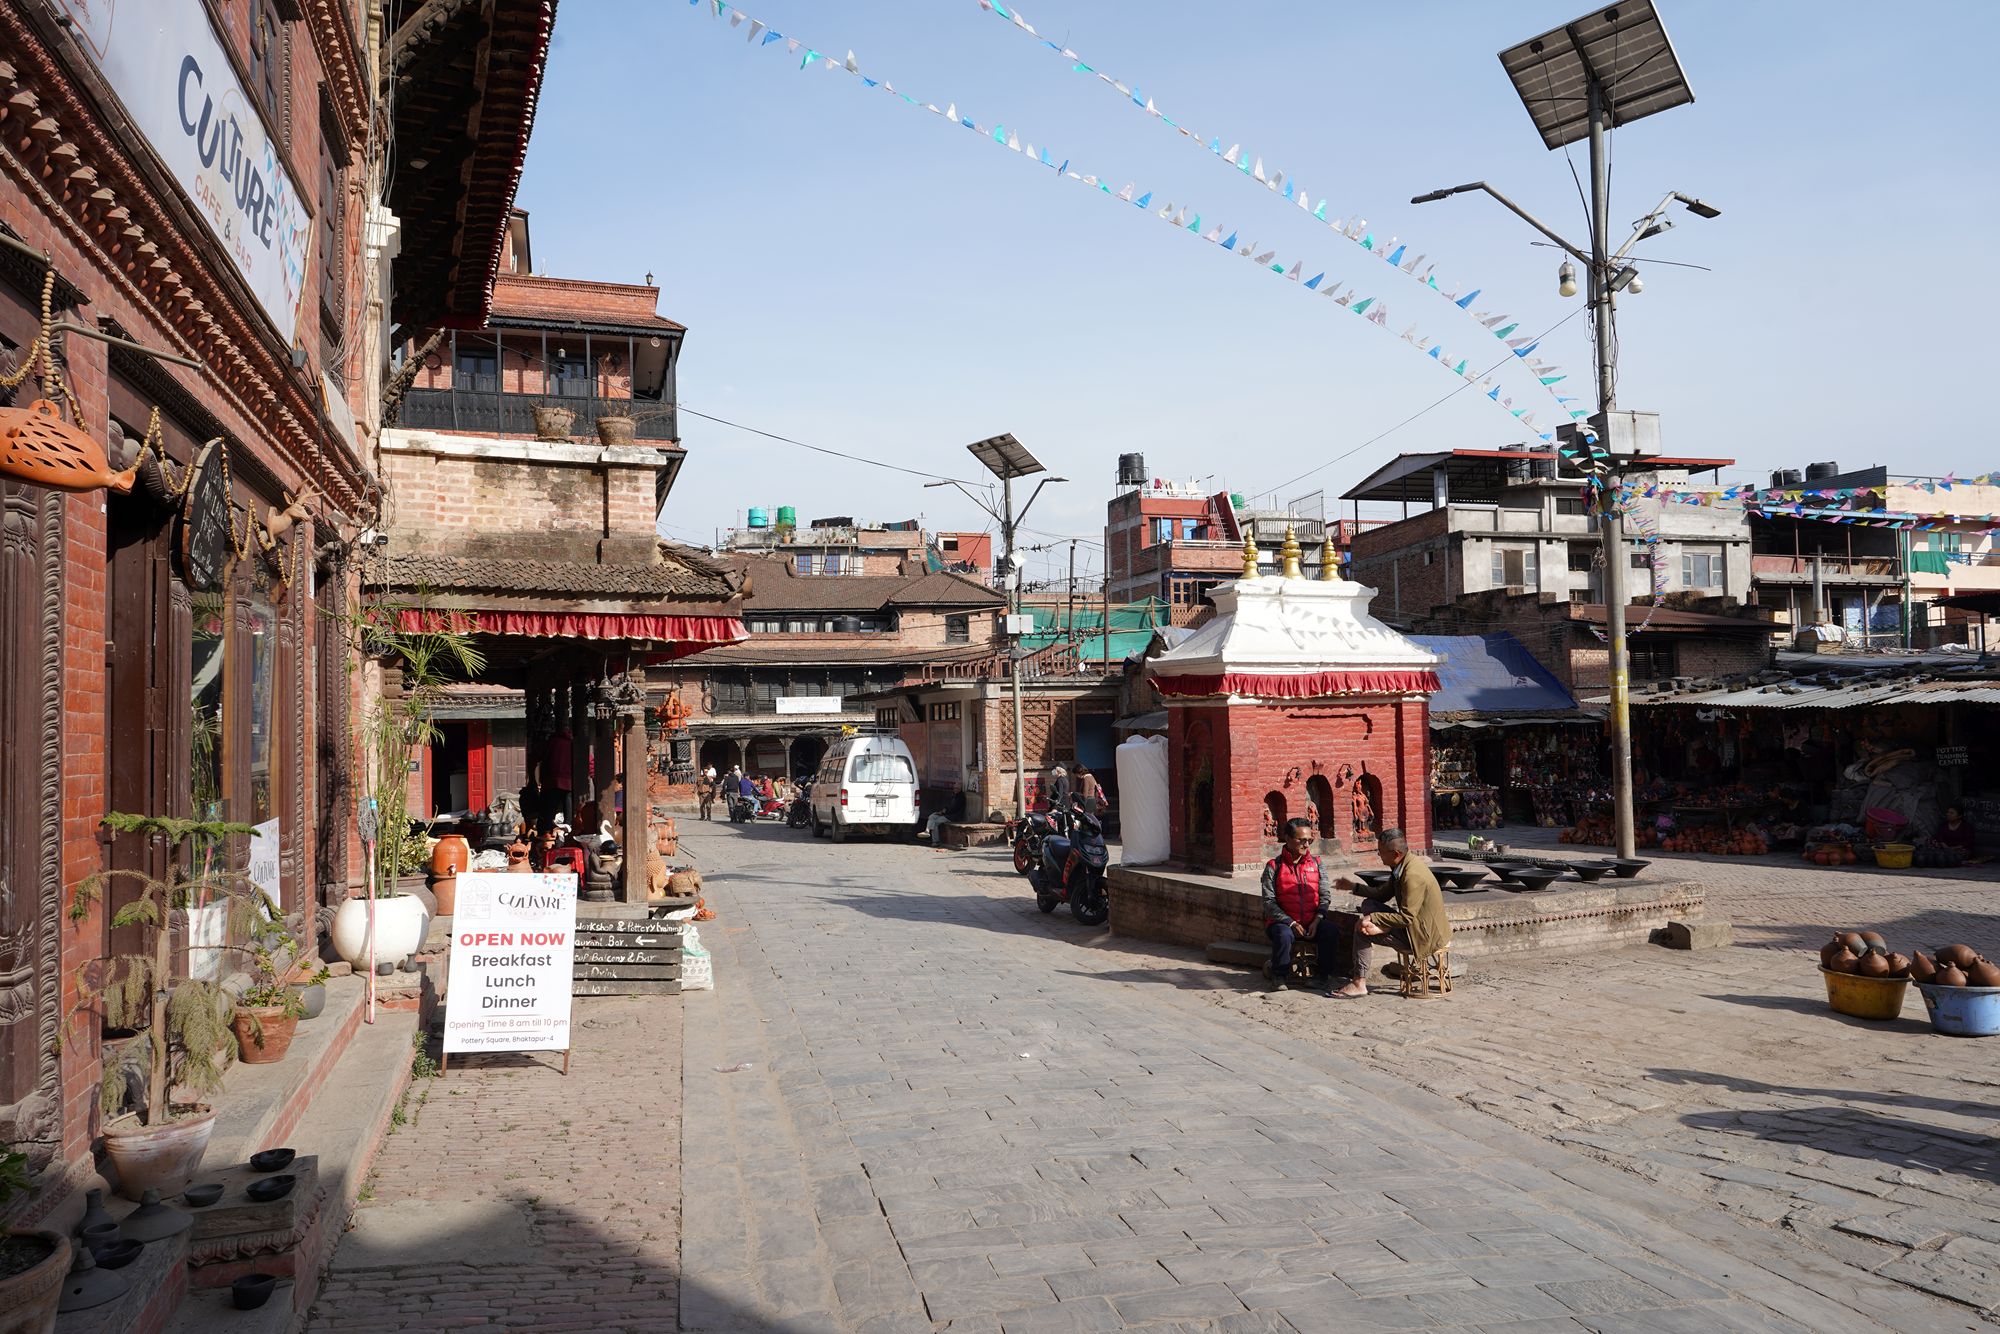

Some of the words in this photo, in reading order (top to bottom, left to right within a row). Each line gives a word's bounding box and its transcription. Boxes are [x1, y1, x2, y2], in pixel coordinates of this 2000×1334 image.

[177, 54, 276, 251] CULTURE
[224, 217, 232, 242] &
[235, 235, 252, 273] BAR
[498, 893, 566, 910] CULTURE
[617, 920, 626, 932] &
[460, 933, 514, 946] OPEN
[520, 932, 566, 946] NOW
[471, 954, 552, 967] Breakfast
[627, 952, 636, 963] &
[636, 952, 656, 963] Bar
[591, 967, 617, 979] Drink
[485, 975, 536, 988] Lunch
[481, 995, 537, 1009] Dinner
[449, 1020, 485, 1030] Opening
[487, 1019, 507, 1028] Time
[508, 1019, 515, 1027] 8
[532, 1018, 542, 1027] till
[543, 1018, 552, 1027] 10
[553, 1019, 567, 1028] pm
[461, 1037, 485, 1045] Pottery
[485, 1036, 511, 1045] Square,
[512, 1035, 554, 1044] Bhaktapur-4
